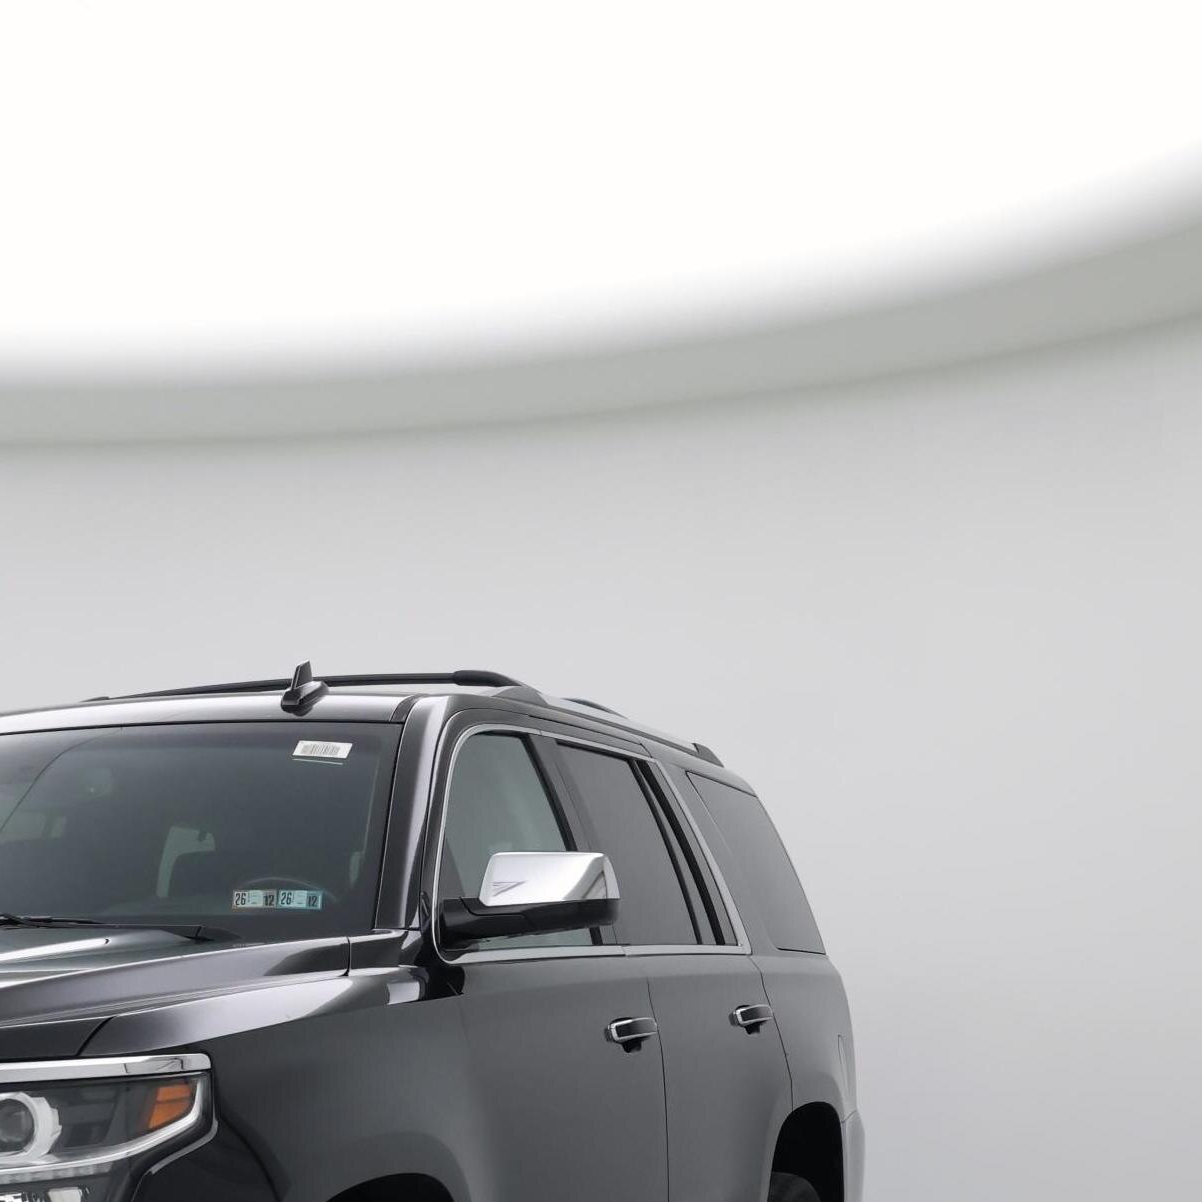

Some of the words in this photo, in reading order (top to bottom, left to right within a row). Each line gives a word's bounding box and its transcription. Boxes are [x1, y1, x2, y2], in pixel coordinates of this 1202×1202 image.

[235, 892, 247, 906] 26
[263, 894, 275, 907] 12
[280, 892, 293, 905] 26
[308, 895, 319, 907] 12
